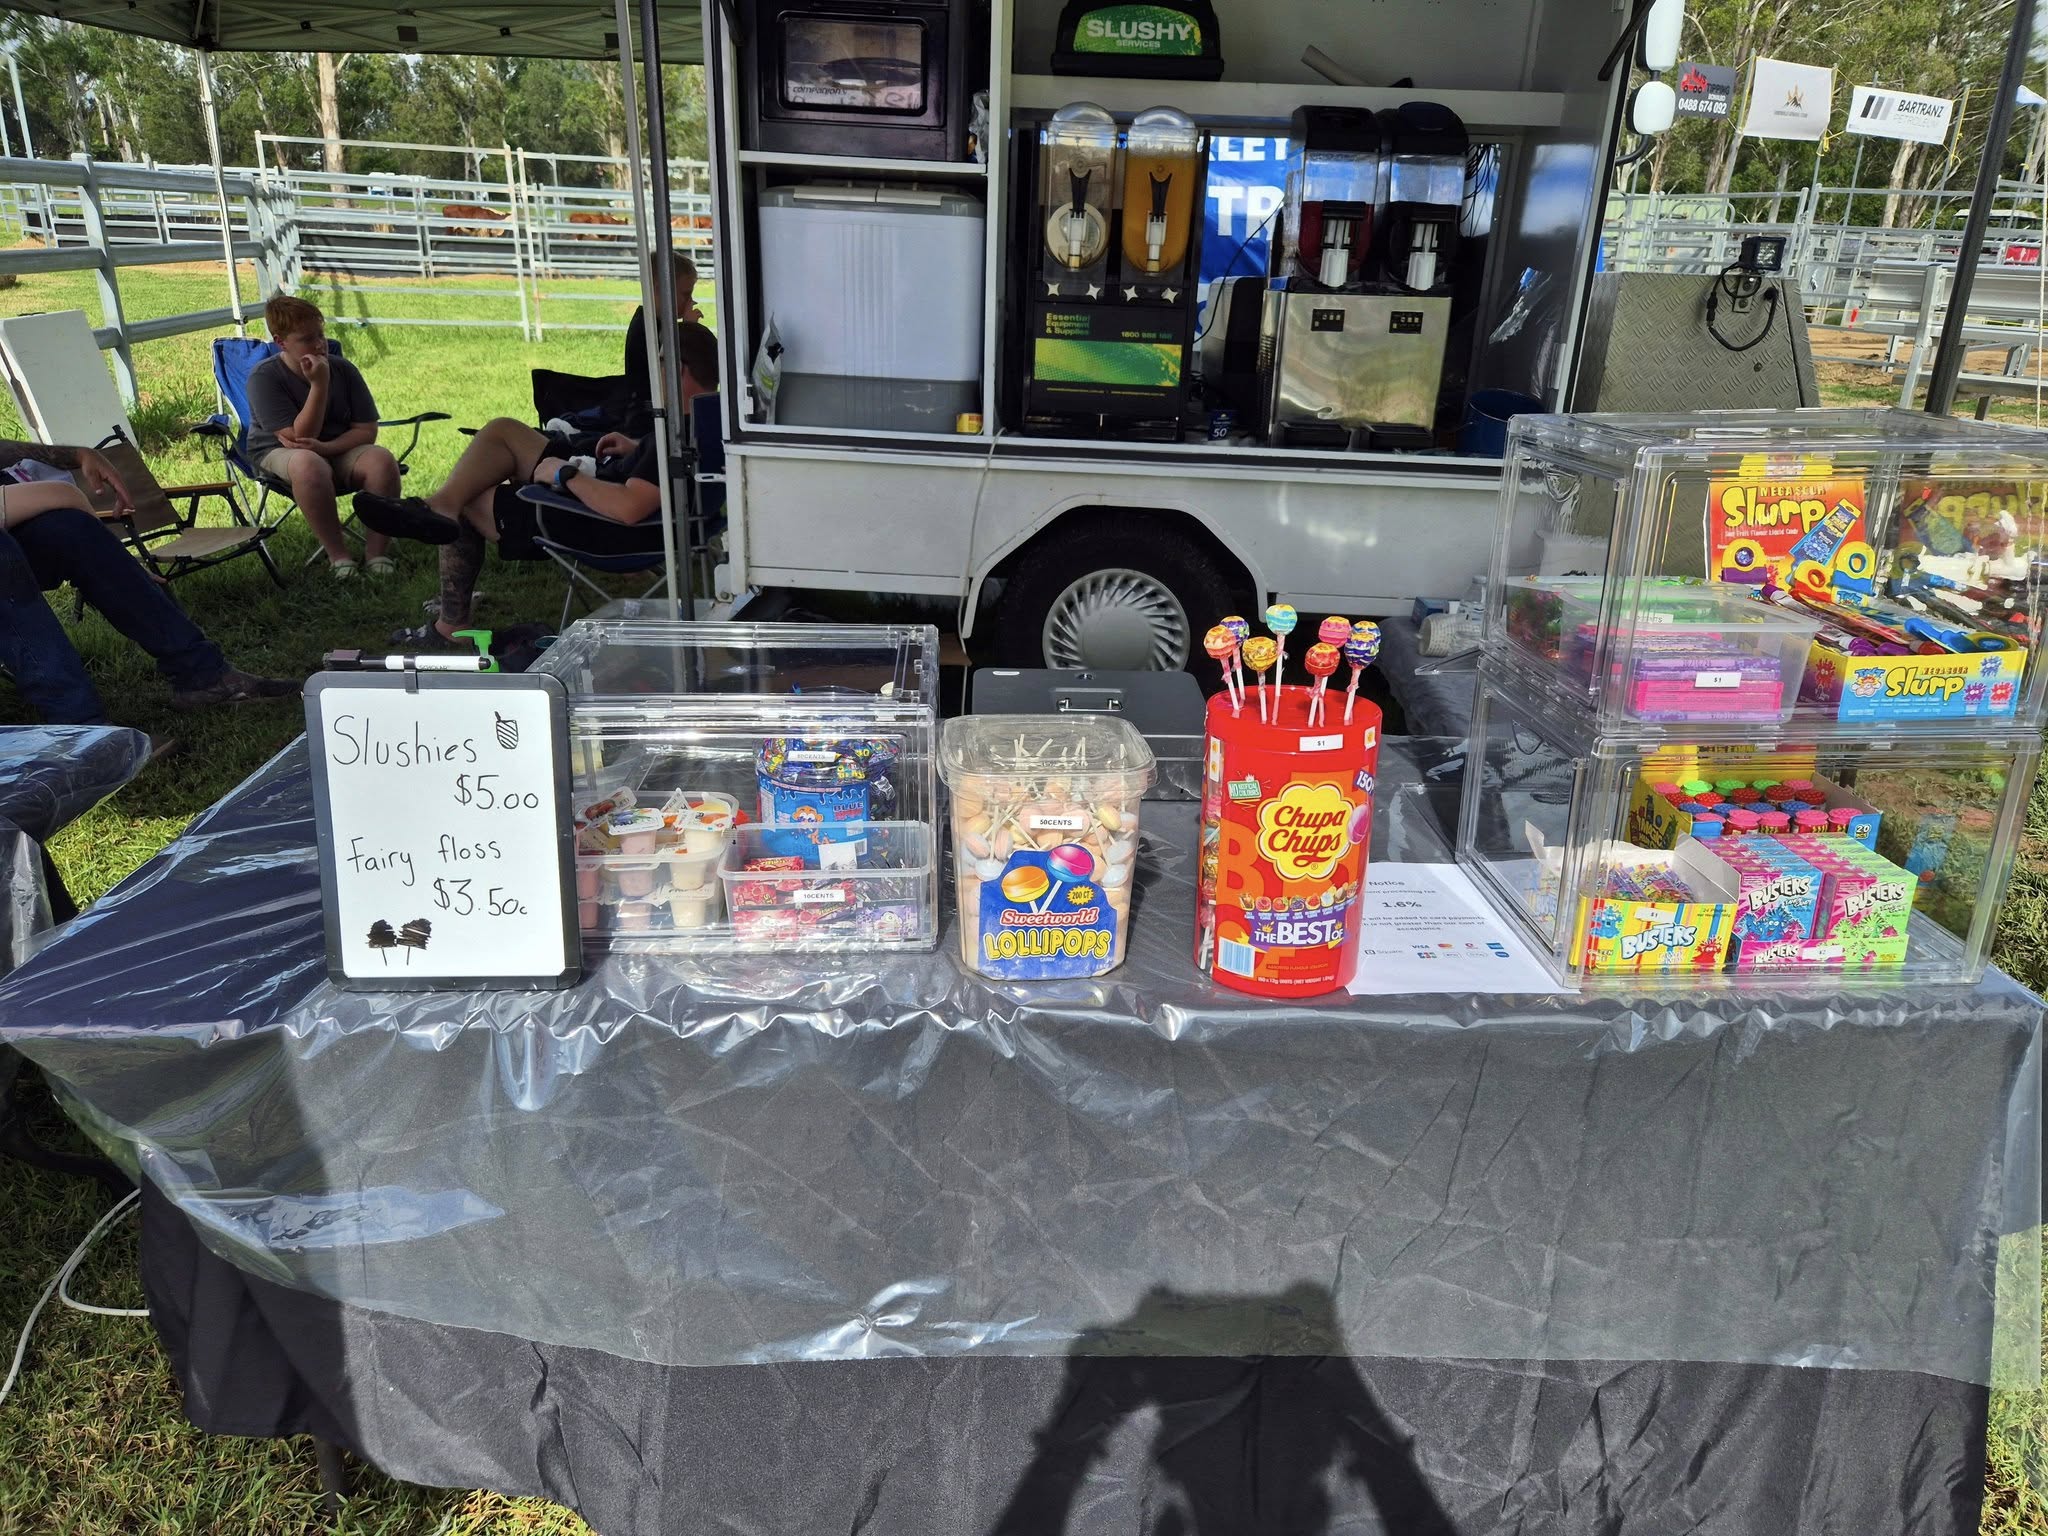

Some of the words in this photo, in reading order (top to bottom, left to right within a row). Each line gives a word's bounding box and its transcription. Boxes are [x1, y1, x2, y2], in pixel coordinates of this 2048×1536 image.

[1087, 19, 1191, 40] SLUSHY
[1116, 40, 1160, 48] SERVICES
[1678, 98, 1698, 111] 0488
[1698, 100, 1712, 113] 674
[1713, 102, 1728, 114] 092
[1898, 100, 1945, 118] BARTRANZ
[1046, 312, 1090, 321] Essential
[1721, 486, 1826, 534] Slurp
[1885, 666, 1965, 701] Slurp
[333, 714, 478, 767] Slushies
[454, 774, 539, 811] $5.00
[1274, 805, 1347, 834] Chupa
[1856, 825, 1871, 833] 20
[347, 837, 415, 887] Fairy
[438, 834, 501, 863] floss
[1268, 829, 1342, 865] Chups
[433, 877, 528, 916] $3.50c
[1072, 892, 1083, 900] 200
[1083, 890, 1091, 899] CT
[1749, 876, 1811, 911] BUSTERS
[1845, 882, 1906, 917] BUSTERS
[1001, 909, 1099, 926] Sweetworld
[1255, 930, 1277, 944] THE
[1277, 919, 1336, 944] BEST
[1331, 928, 1344, 940] OF
[984, 929, 1112, 961] LOLLIPOPS
[1621, 923, 1697, 960] BUSTERS
